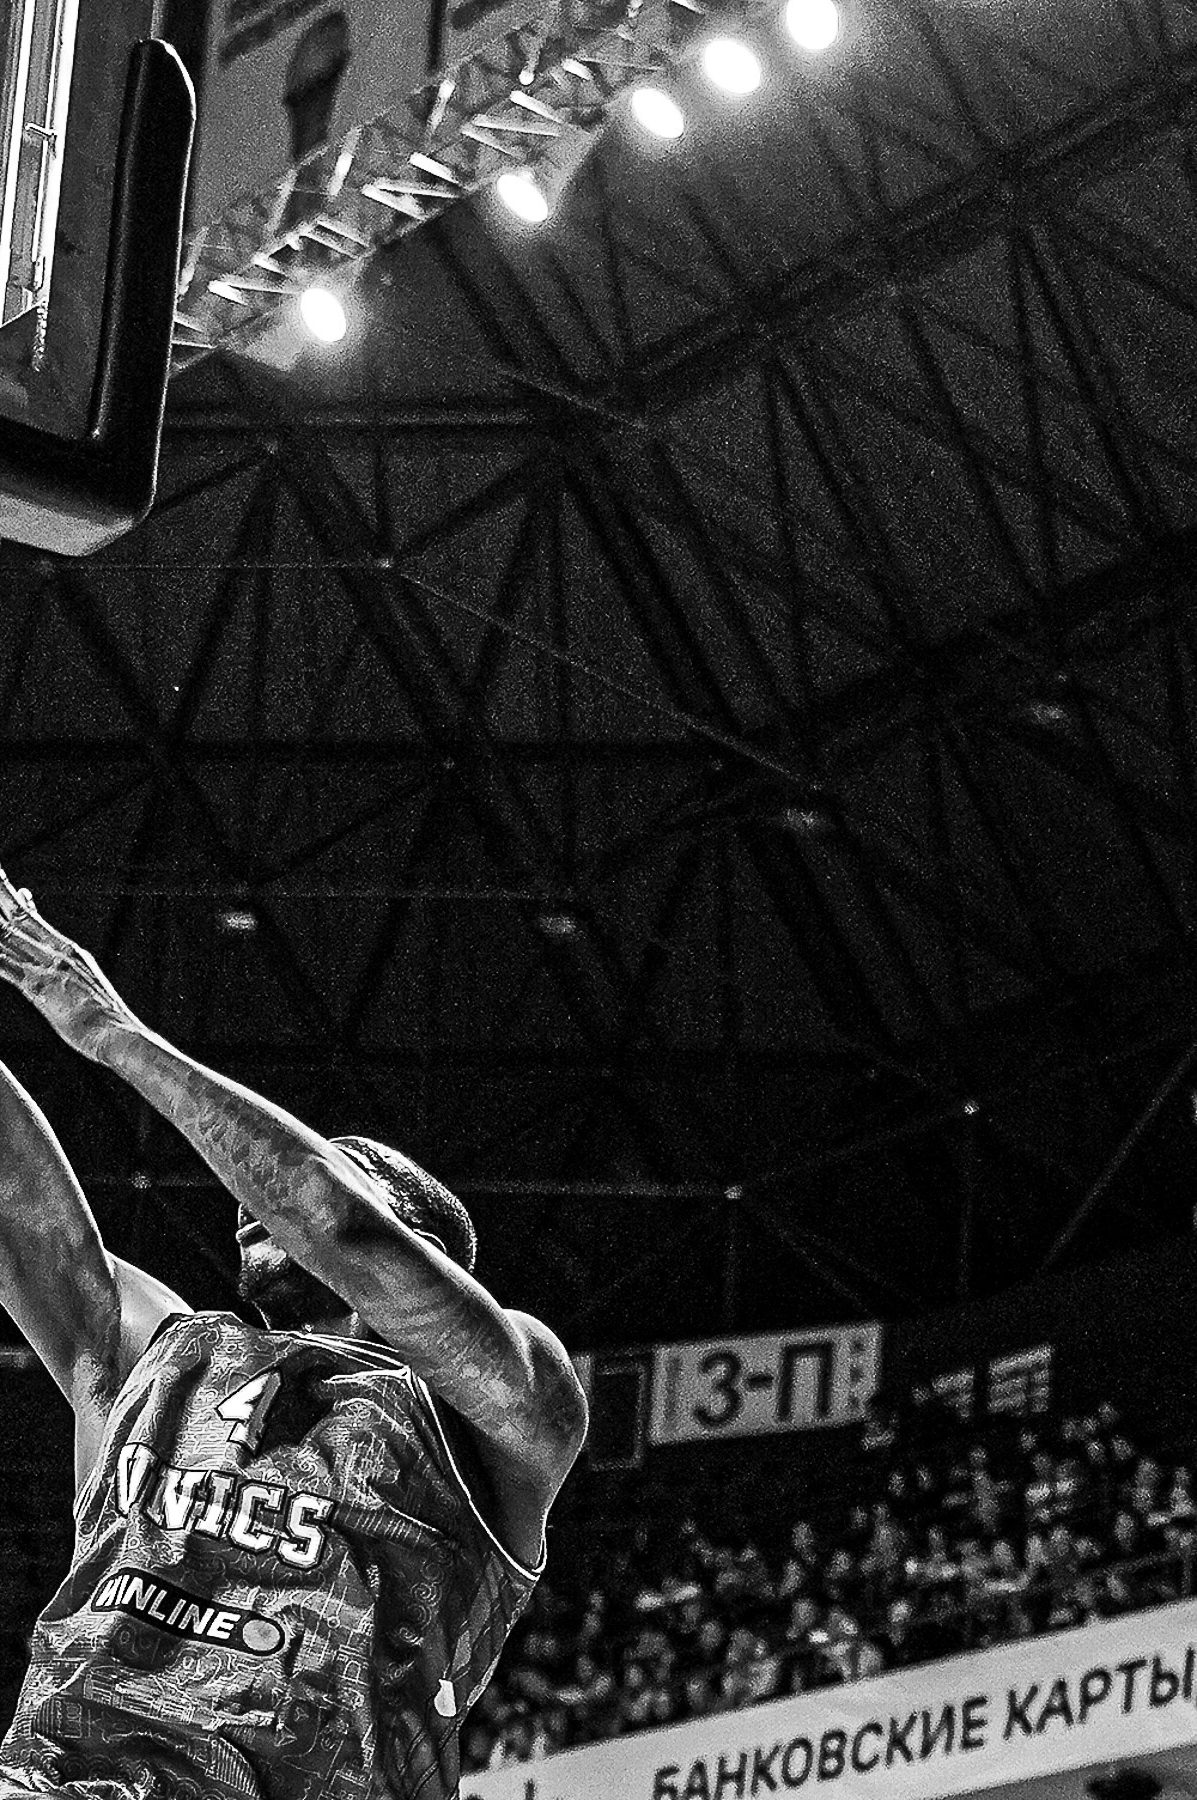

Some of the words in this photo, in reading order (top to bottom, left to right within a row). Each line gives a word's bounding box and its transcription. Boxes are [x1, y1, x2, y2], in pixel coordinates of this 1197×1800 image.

[693, 1338, 835, 1427] 3-П
[115, 1442, 337, 1569] UNICS
[1003, 1646, 1196, 1741] КАРТЫ
